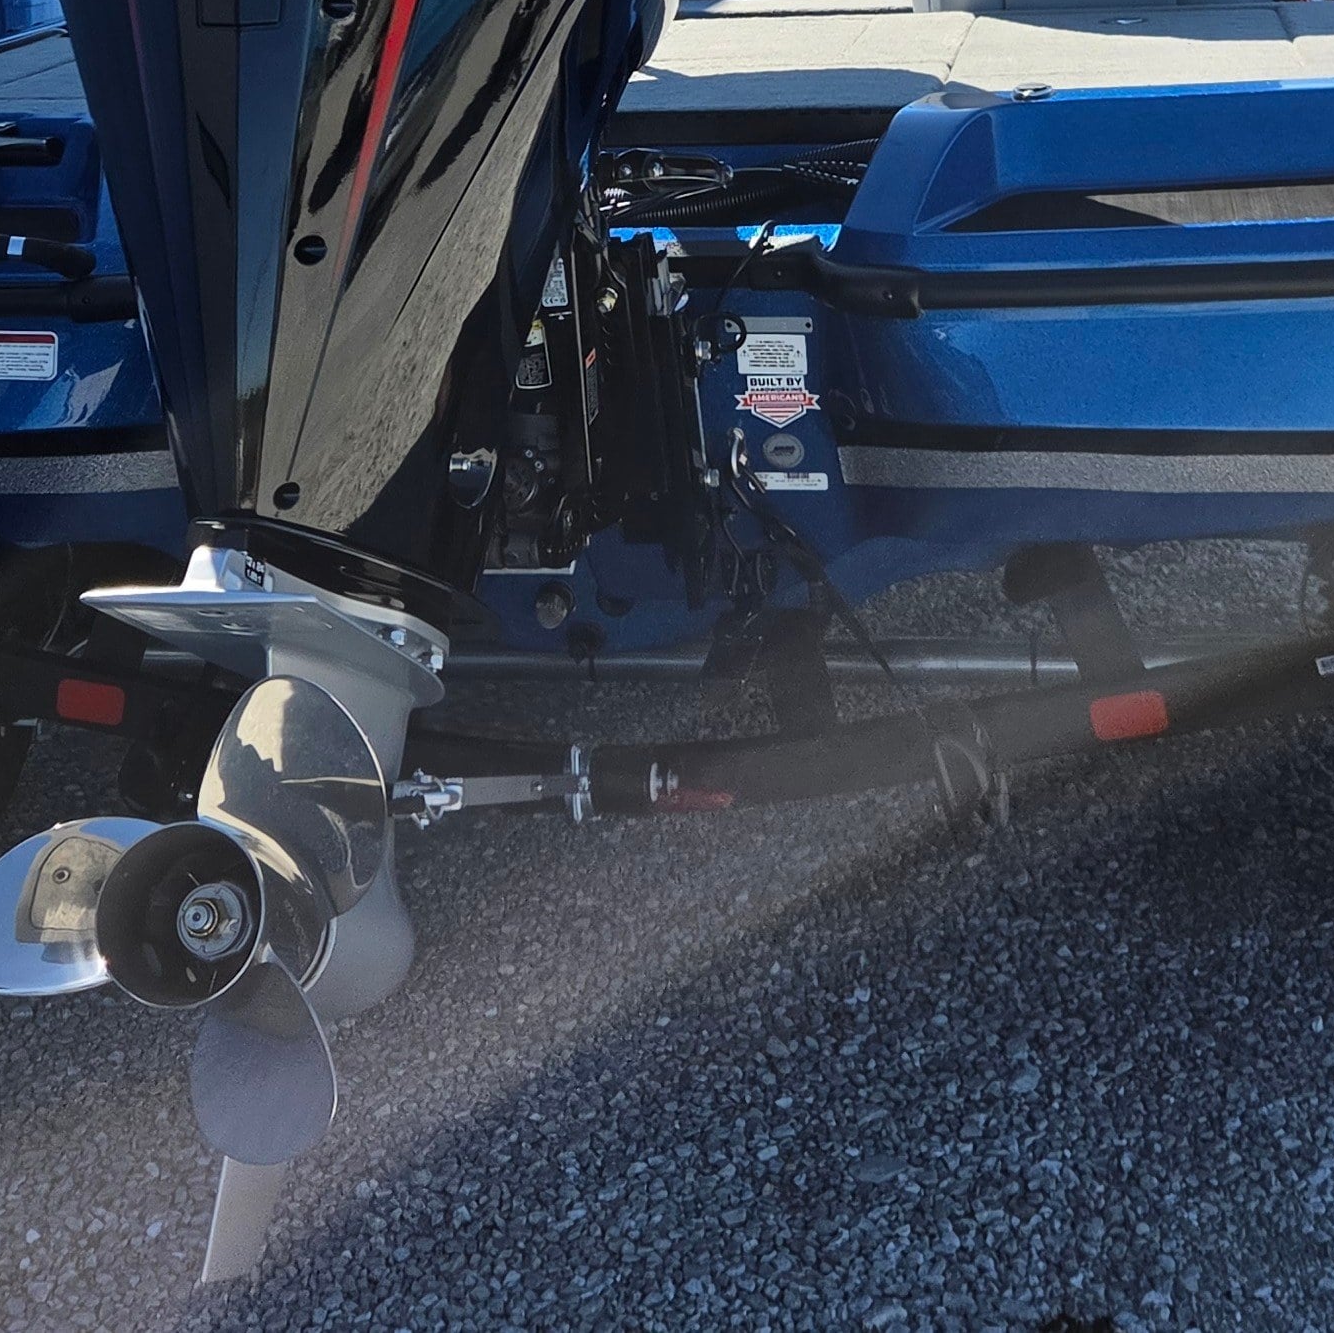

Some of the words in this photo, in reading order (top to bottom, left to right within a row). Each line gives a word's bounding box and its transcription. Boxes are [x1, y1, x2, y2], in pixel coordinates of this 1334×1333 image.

[750, 377, 783, 386] BUILT
[786, 377, 802, 386] BY
[751, 394, 804, 402] AMERICANS
